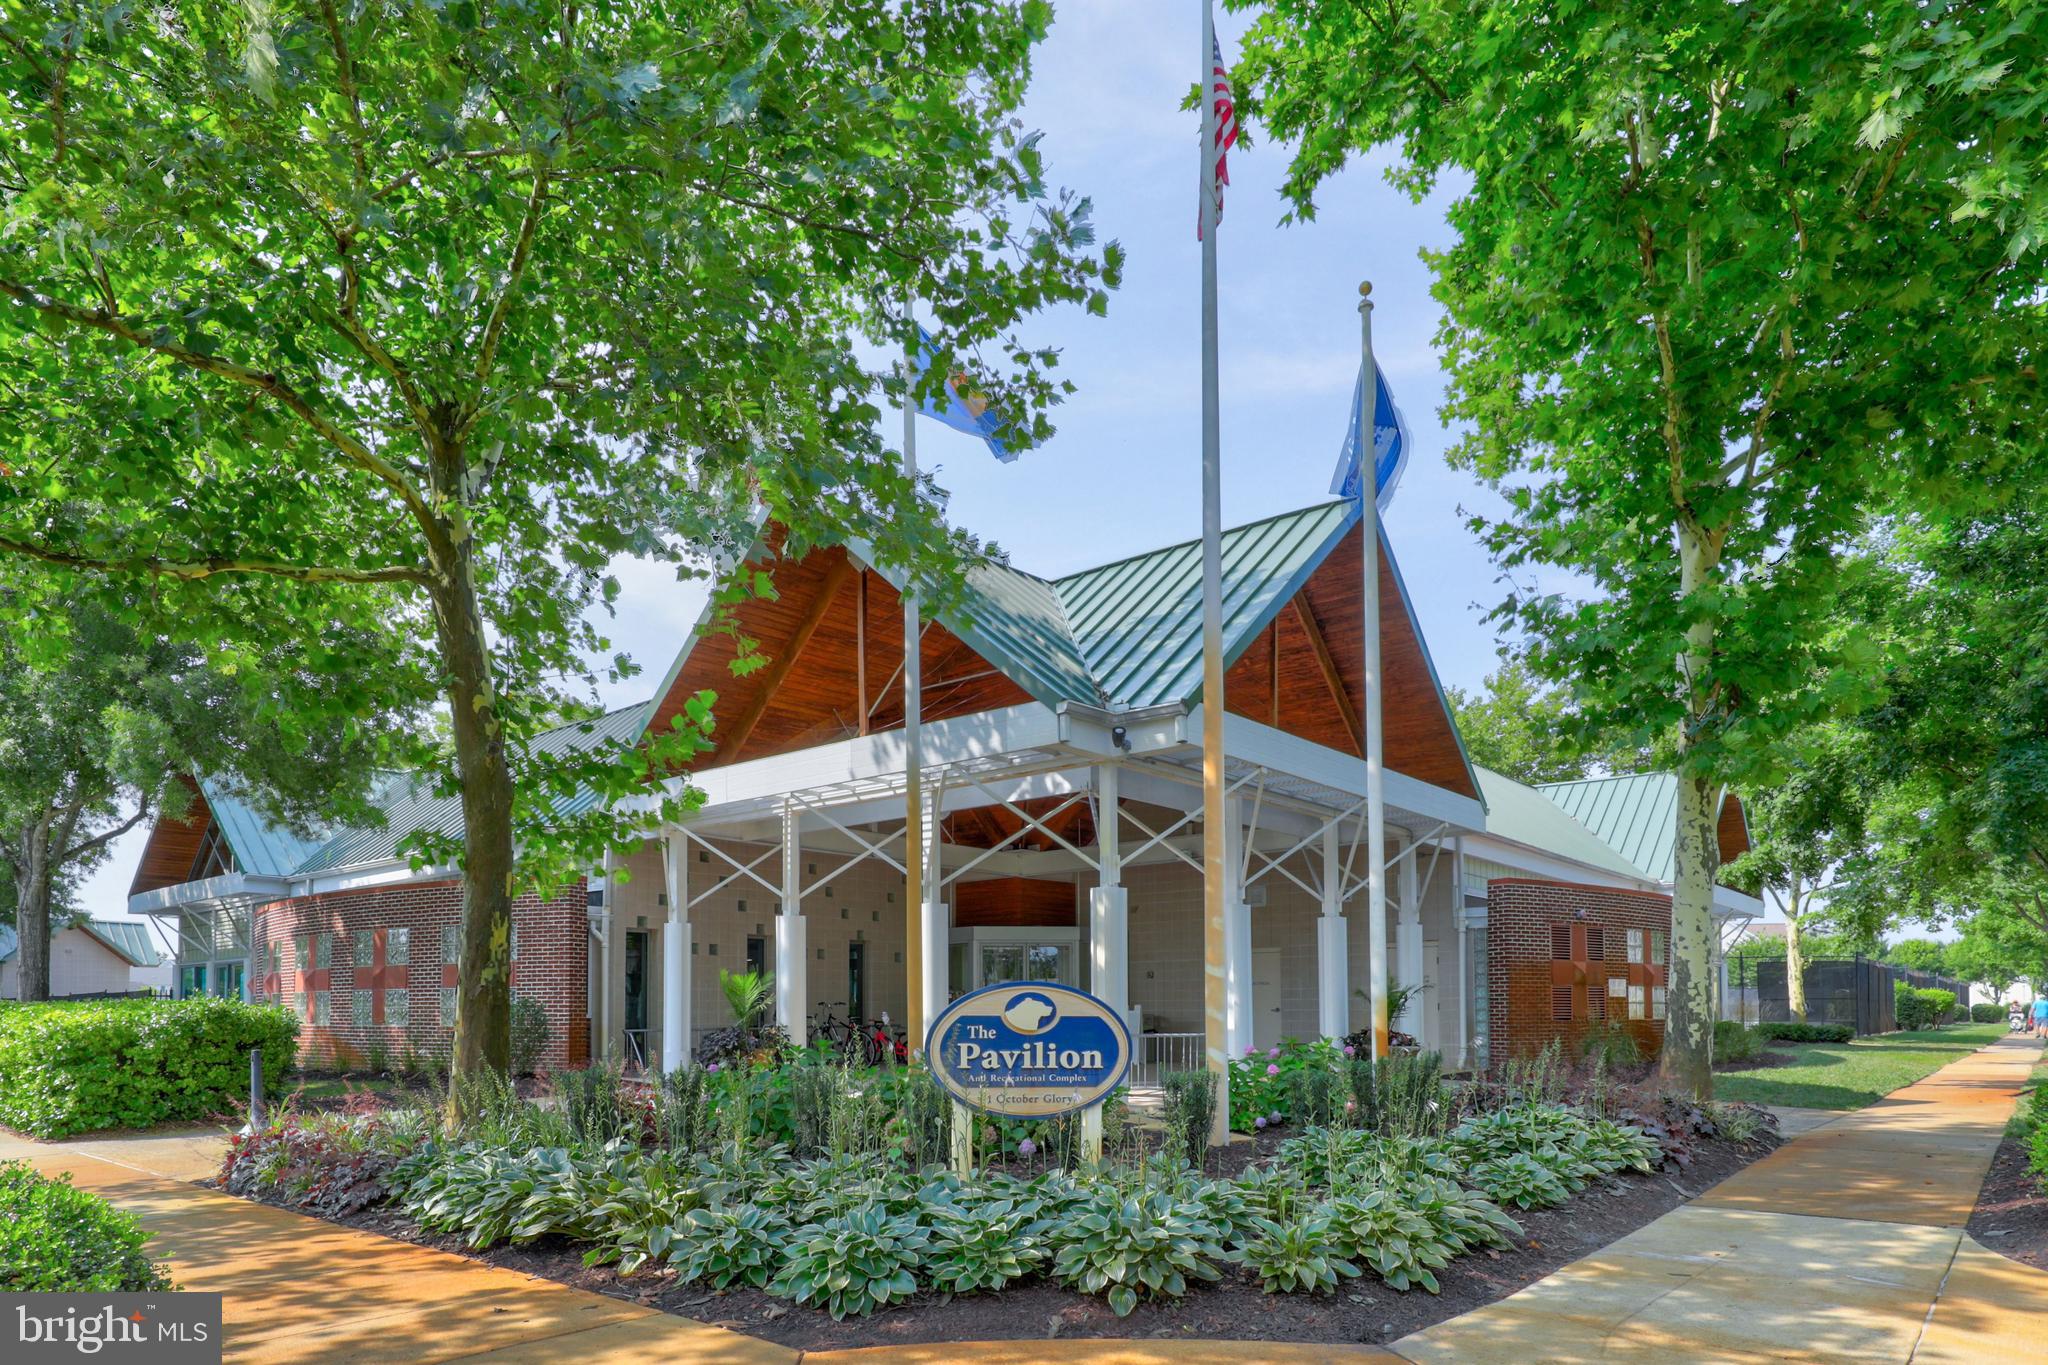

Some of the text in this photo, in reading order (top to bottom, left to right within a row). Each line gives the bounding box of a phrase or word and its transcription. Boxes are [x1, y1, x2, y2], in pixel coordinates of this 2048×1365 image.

[967, 1025, 997, 1039] The
[957, 1042, 1104, 1069] Pavilion
[990, 1073, 1046, 1083] Receational
[1049, 1073, 1087, 1084] Complex
[996, 1094, 1039, 1104] October
[1043, 1094, 1073, 1105] Glory
